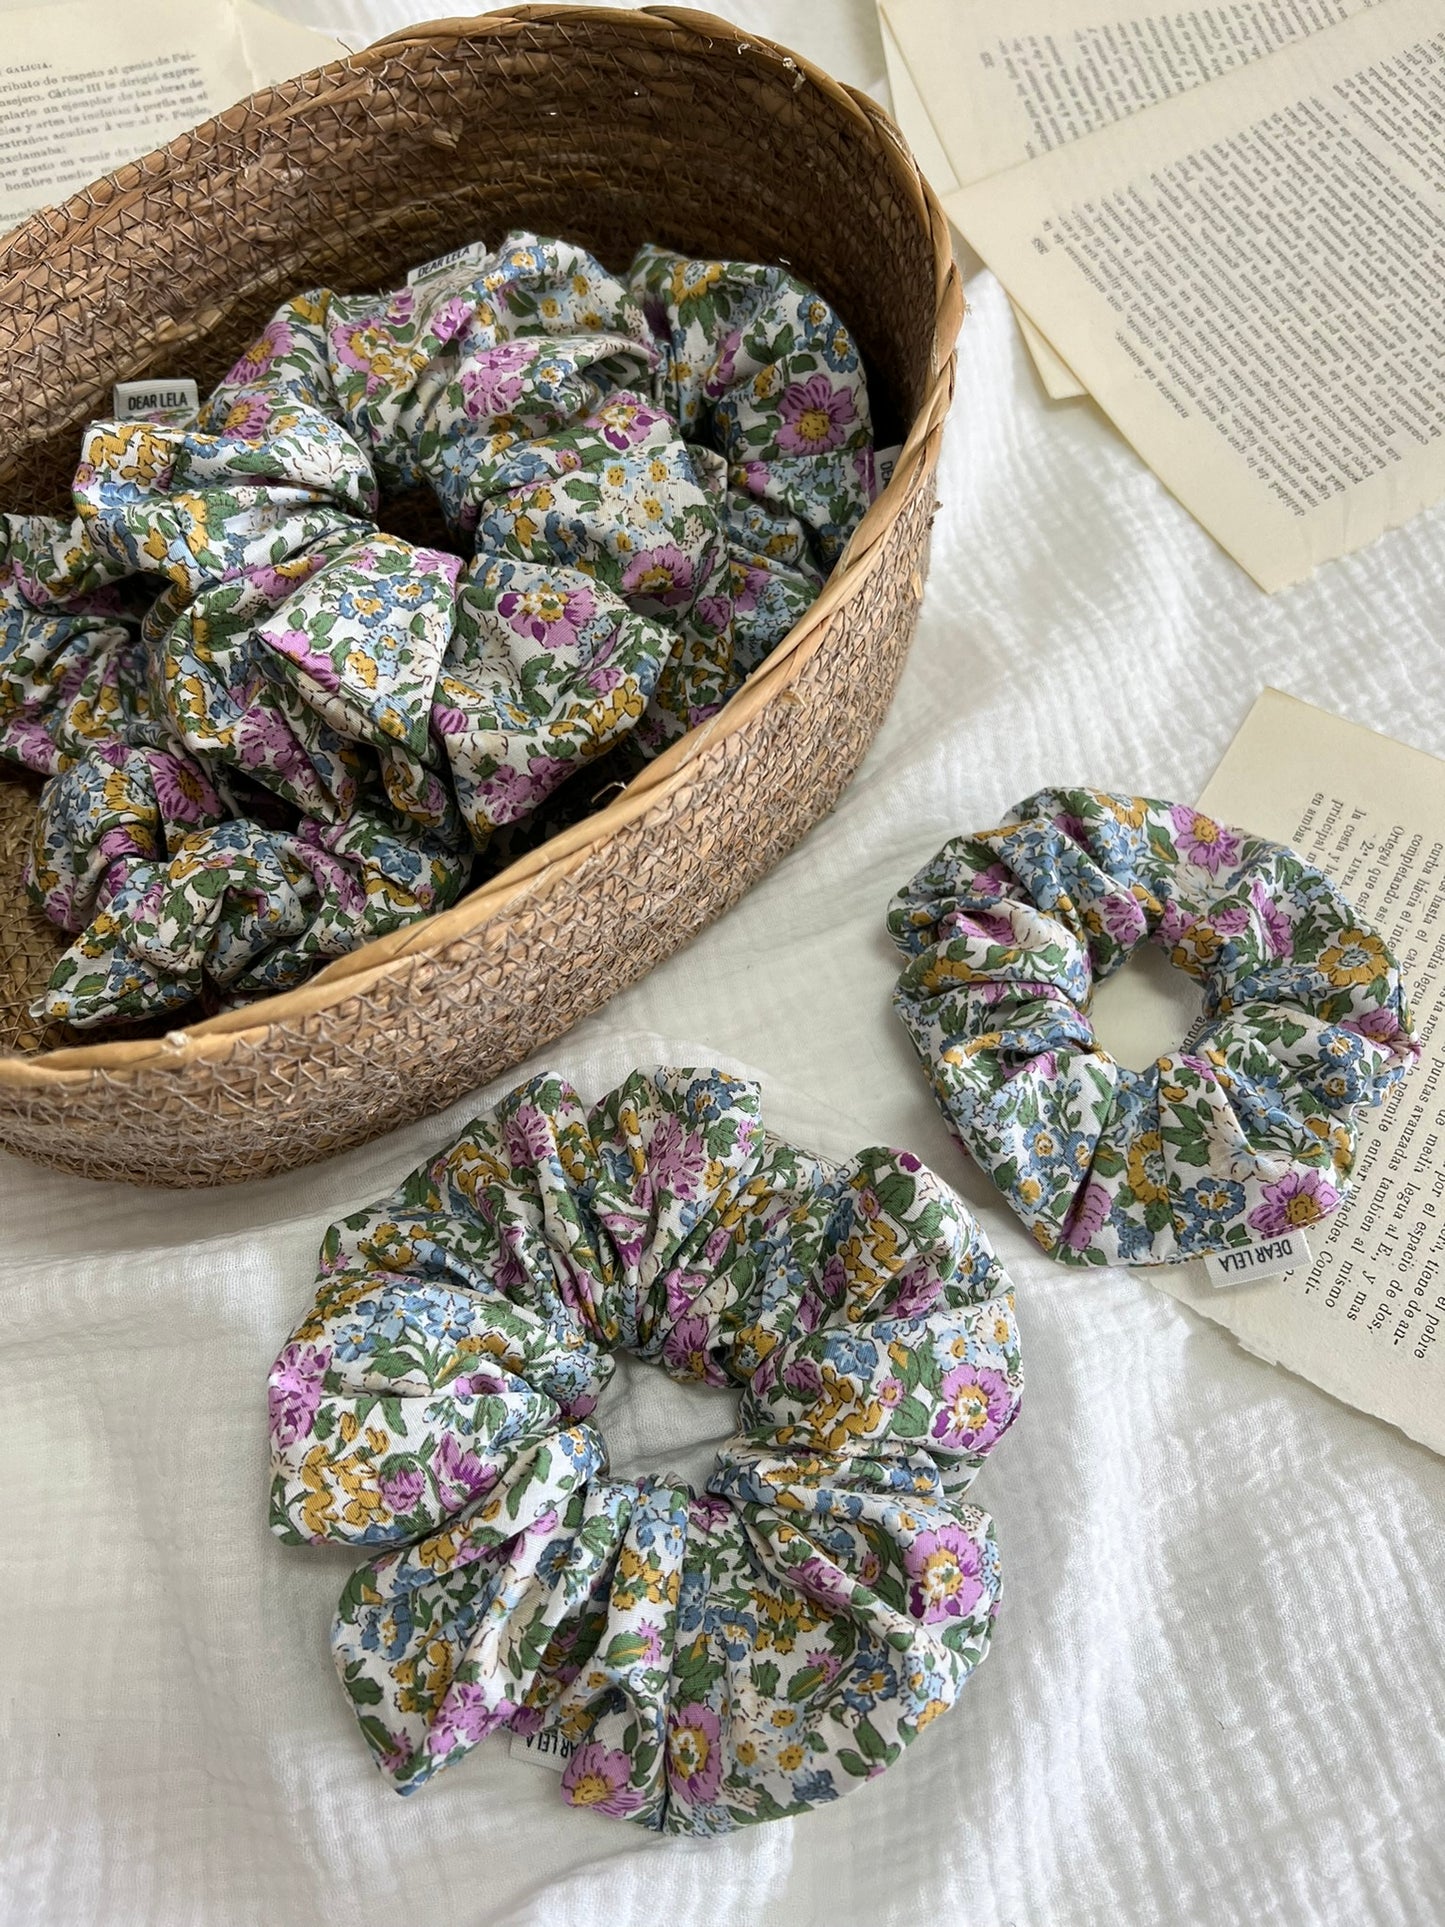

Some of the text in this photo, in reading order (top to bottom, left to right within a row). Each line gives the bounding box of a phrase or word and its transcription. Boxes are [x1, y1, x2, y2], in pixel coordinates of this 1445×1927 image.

[416, 245, 471, 277] DEAR LELA
[128, 391, 187, 410] DEAR LELA
[1311, 792, 1324, 806] en
[1351, 808, 1366, 819] la
[1292, 808, 1316, 843] ambas
[1312, 799, 1343, 851] principal
[1335, 824, 1354, 851] costa
[1328, 852, 1340, 862] y
[1376, 826, 1404, 866] Ortegal
[1422, 842, 1443, 874] curba
[1364, 867, 1381, 889] que
[1374, 834, 1422, 924] completando asi
[1406, 878, 1429, 907] hácia
[1399, 910, 1412, 923] el
[1422, 894, 1445, 924] hasta
[1414, 929, 1427, 942] el
[1406, 972, 1436, 1005] legua
[1378, 1079, 1407, 1131] permite
[1356, 1138, 1381, 1181] entrar
[1413, 1133, 1437, 1172] media
[1325, 1057, 1444, 1307] puntas avanzadas tambien al mismo
[1393, 1182, 1420, 1219] legua
[1384, 1223, 1398, 1239] al
[1218, 1239, 1293, 1272] DEAR LELA
[1366, 1170, 1445, 1331] por el espacio de dos,
[1370, 1242, 1392, 1260] E.,
[1305, 1250, 1332, 1293] Conti-
[1362, 1270, 1376, 1284] y
[1413, 1259, 1439, 1296] tiene
[1346, 1291, 1366, 1320] mas
[1403, 1299, 1421, 1318] de
[1393, 1319, 1409, 1345] an-
[1414, 1313, 1439, 1358] pobre
[526, 1731, 558, 1755] LELA
